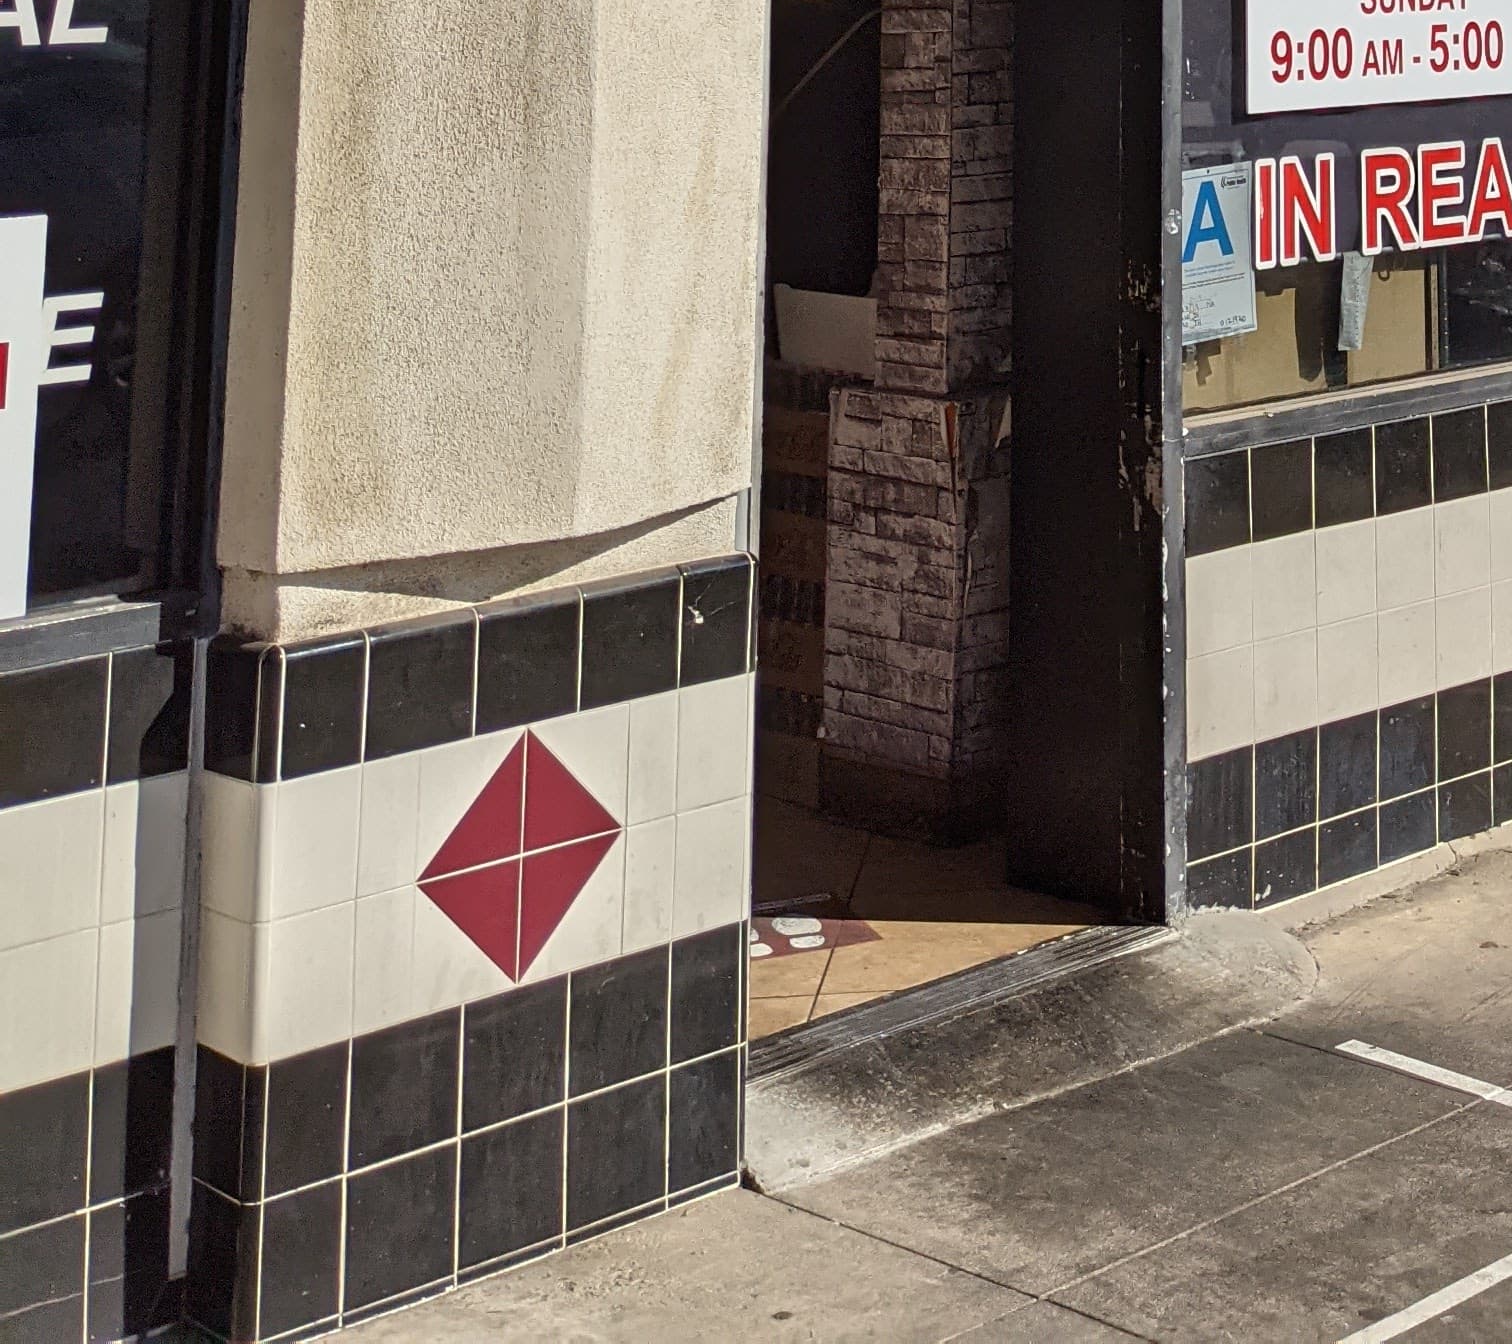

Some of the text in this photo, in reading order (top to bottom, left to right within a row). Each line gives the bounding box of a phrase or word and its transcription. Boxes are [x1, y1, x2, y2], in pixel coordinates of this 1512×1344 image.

[1270, 27, 1353, 83] 9:00
[1362, 40, 1404, 76] AM
[1429, 20, 1502, 72] 5:00
[1183, 180, 1235, 263] A
[1253, 152, 1337, 271] IN
